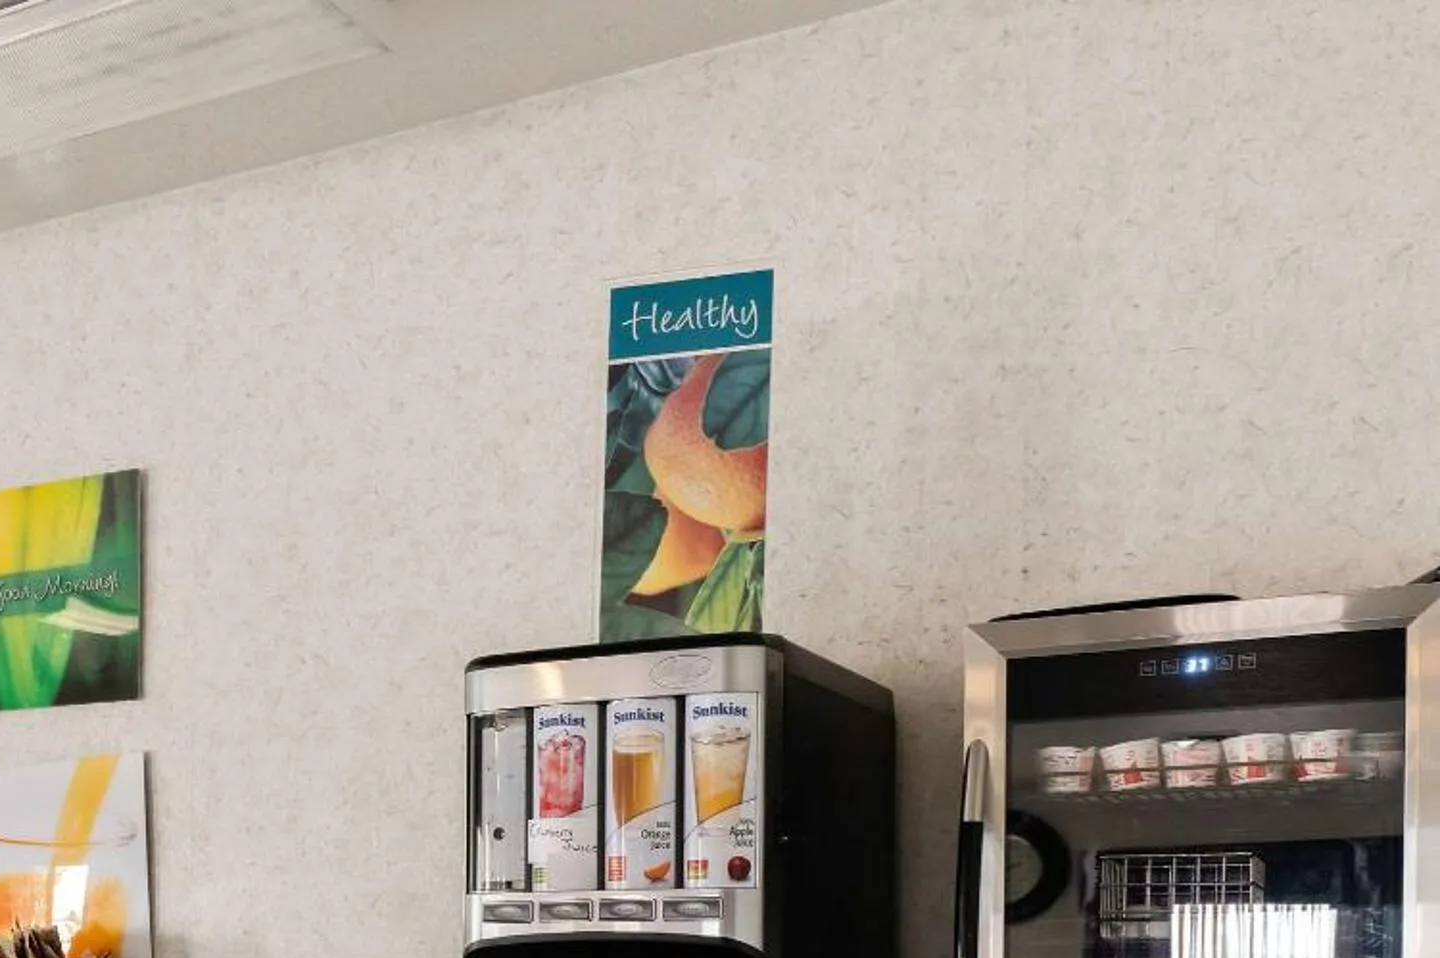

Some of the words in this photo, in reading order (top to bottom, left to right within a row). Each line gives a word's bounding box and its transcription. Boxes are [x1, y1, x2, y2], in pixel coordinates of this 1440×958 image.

[622, 294, 758, 341] Healthy
[613, 707, 666, 725] Sunkist
[692, 702, 748, 720] Sunkist
[538, 713, 586, 730] Sunkist
